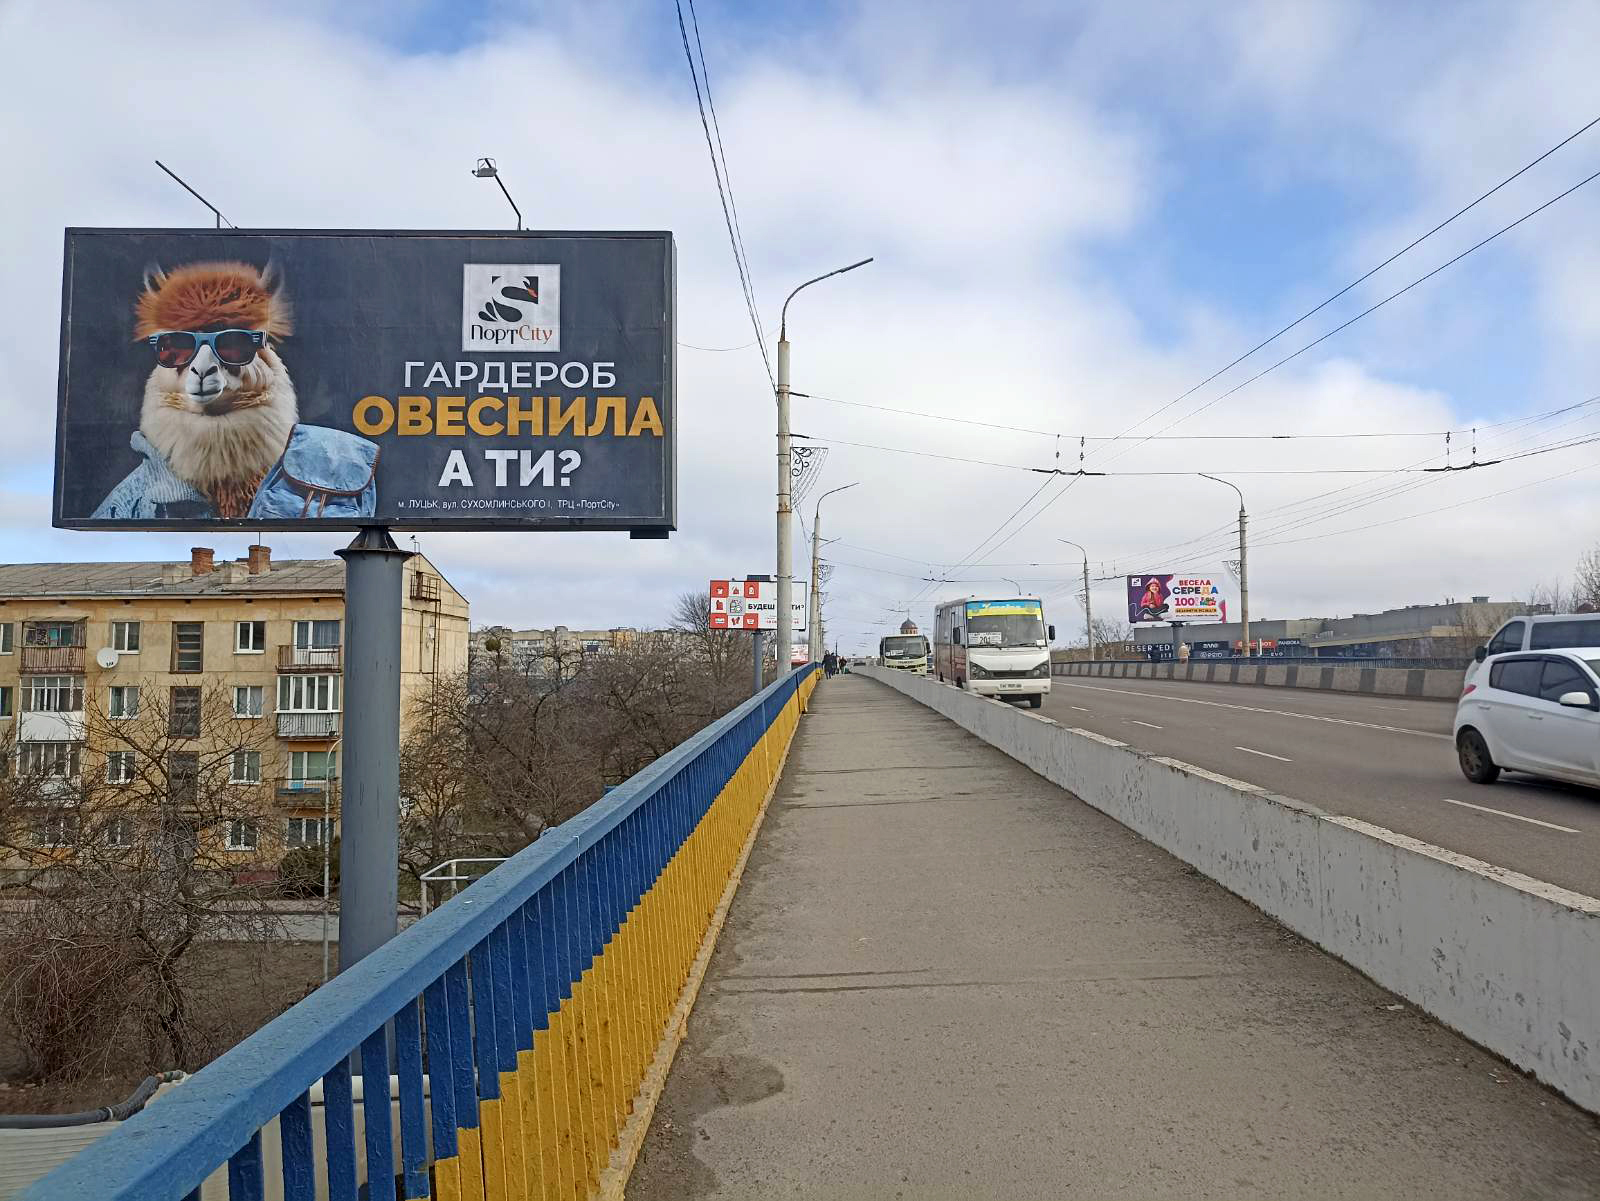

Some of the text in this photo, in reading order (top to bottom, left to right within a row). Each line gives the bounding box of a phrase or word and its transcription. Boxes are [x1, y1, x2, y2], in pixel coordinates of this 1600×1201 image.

[404, 361, 617, 393] ГАРДЕРОБ
[352, 395, 664, 437] ОВЕСНИЛА
[438, 449, 582, 487] А ТИ?
[408, 499, 441, 510] ЛУЦЬК,
[442, 501, 459, 510] вул.
[460, 499, 546, 509] СУХОМЛИНСЬКОГО
[557, 499, 575, 510] ТРЦ
[1172, 586, 1219, 595] СЕРЕДА
[1175, 597, 1195, 607] 100
